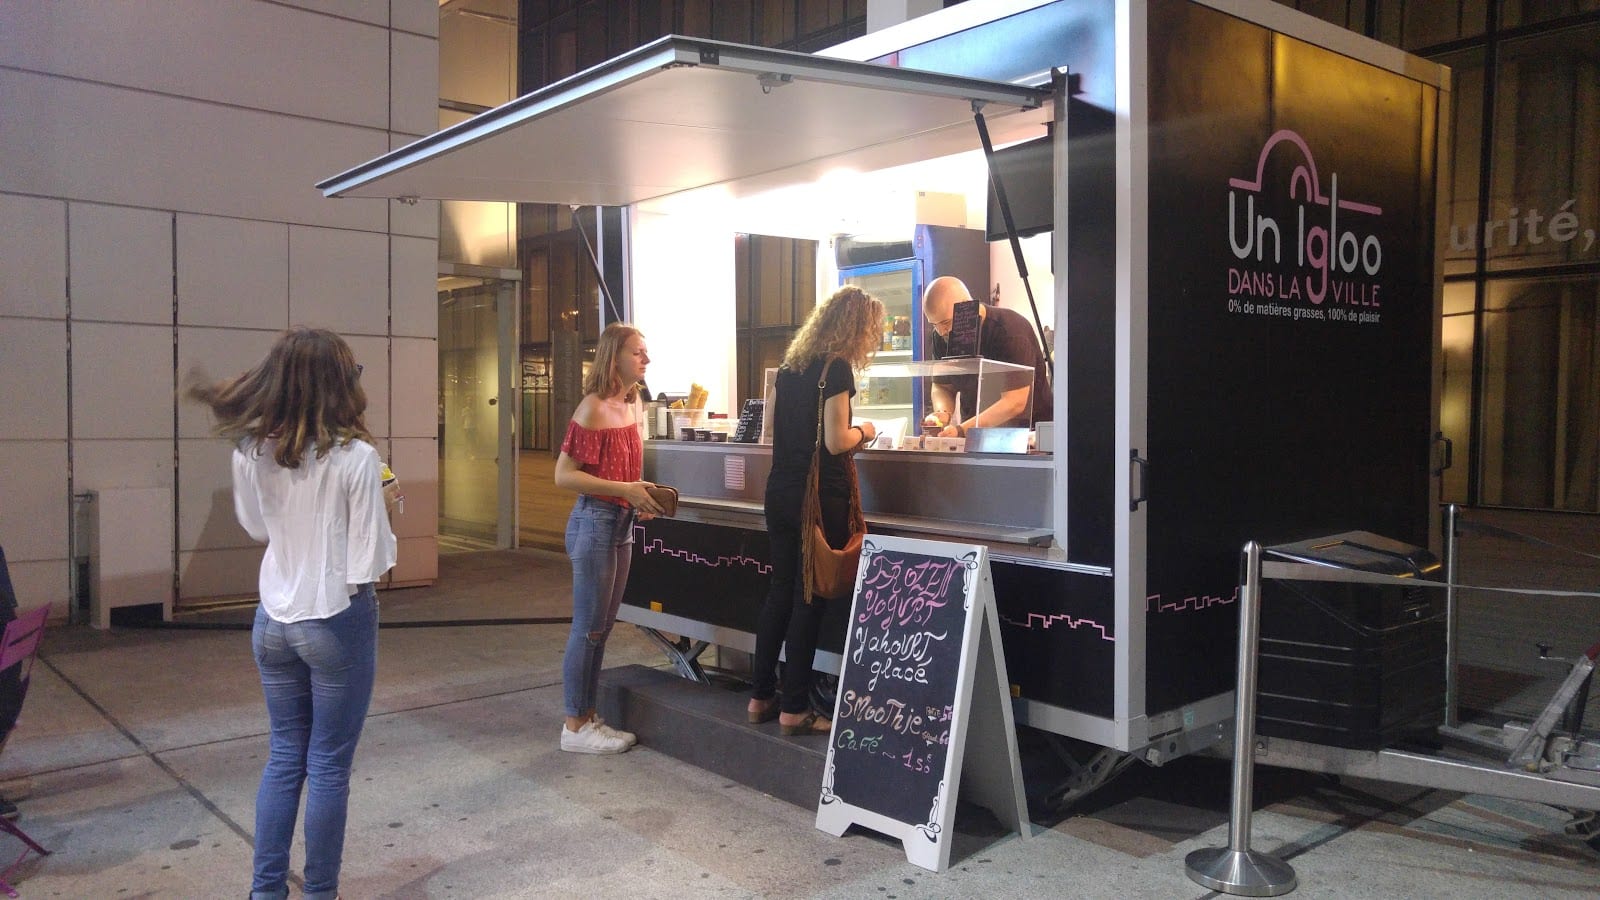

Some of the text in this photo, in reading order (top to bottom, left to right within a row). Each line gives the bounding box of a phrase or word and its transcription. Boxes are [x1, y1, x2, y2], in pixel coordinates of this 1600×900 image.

[1229, 172, 1382, 304] Un Igloo
[1228, 268, 1381, 307] DANS LA VILLE
[1228, 298, 1381, 325] 0% de matières grasses, 100% de plaisir
[868, 657, 933, 691] glacé
